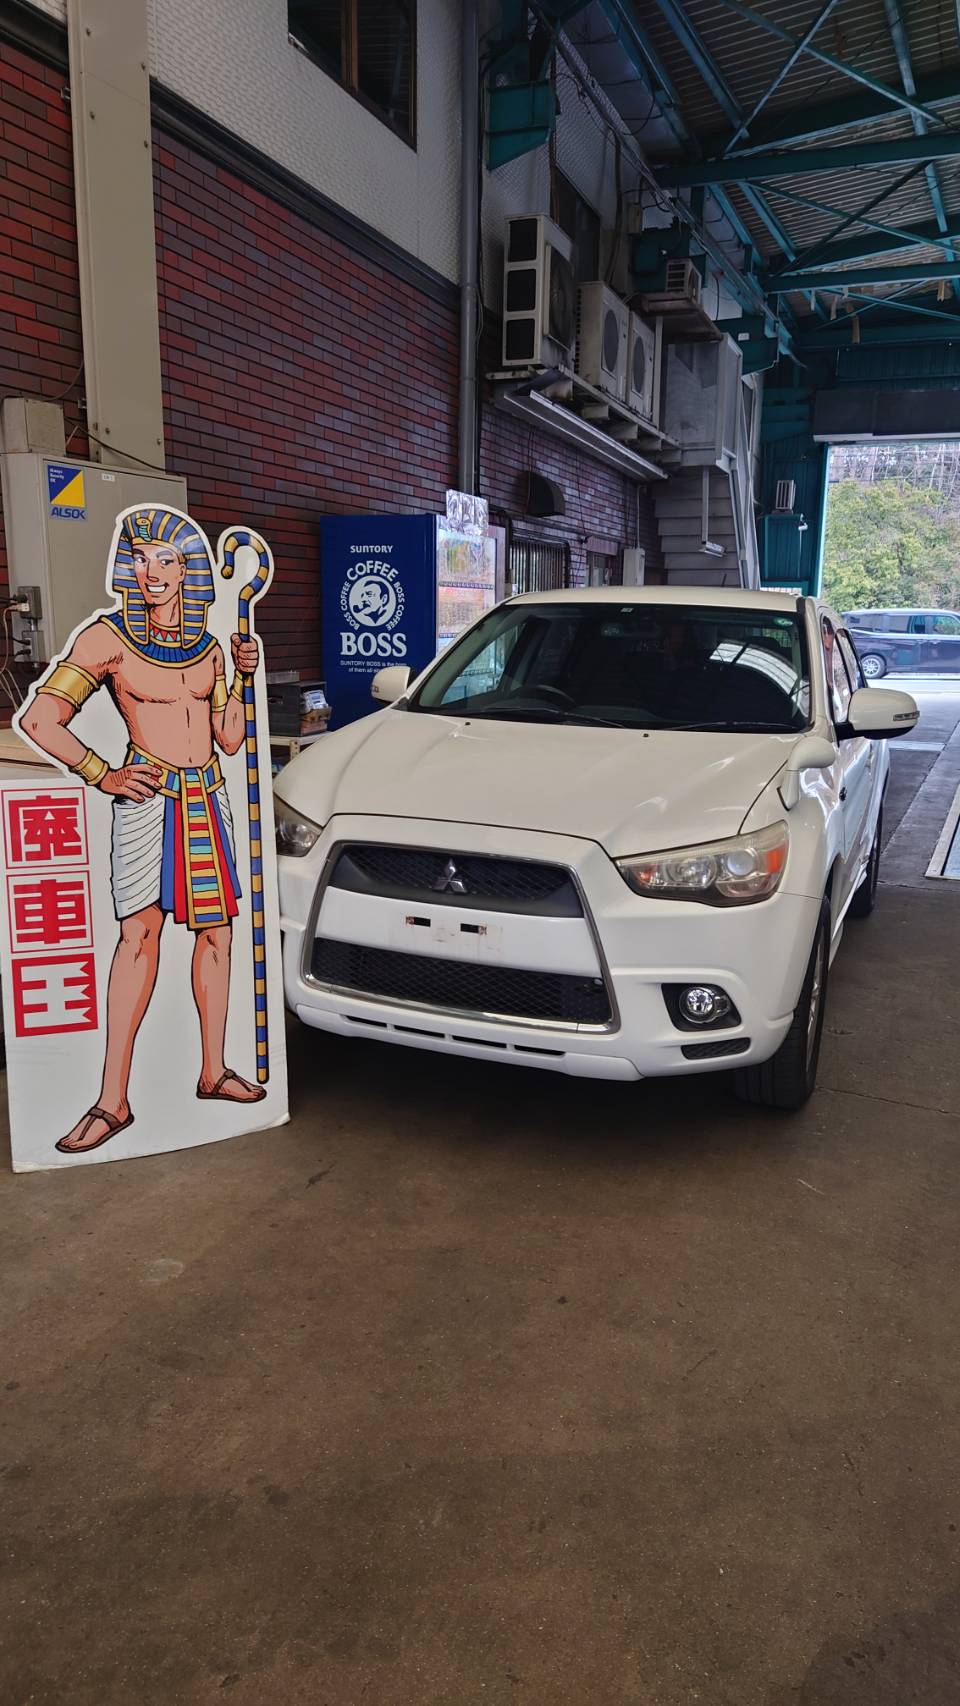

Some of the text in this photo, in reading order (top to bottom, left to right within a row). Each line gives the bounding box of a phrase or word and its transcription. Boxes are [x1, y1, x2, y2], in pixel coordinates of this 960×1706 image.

[51, 507, 86, 520] ALSOK
[350, 545, 393, 553] SUNTORY
[346, 560, 399, 582] COFFEE
[340, 581, 360, 631] BOSS COFFEE
[385, 581, 405, 631] BOSS COFFEE
[340, 632, 407, 657] BOSS
